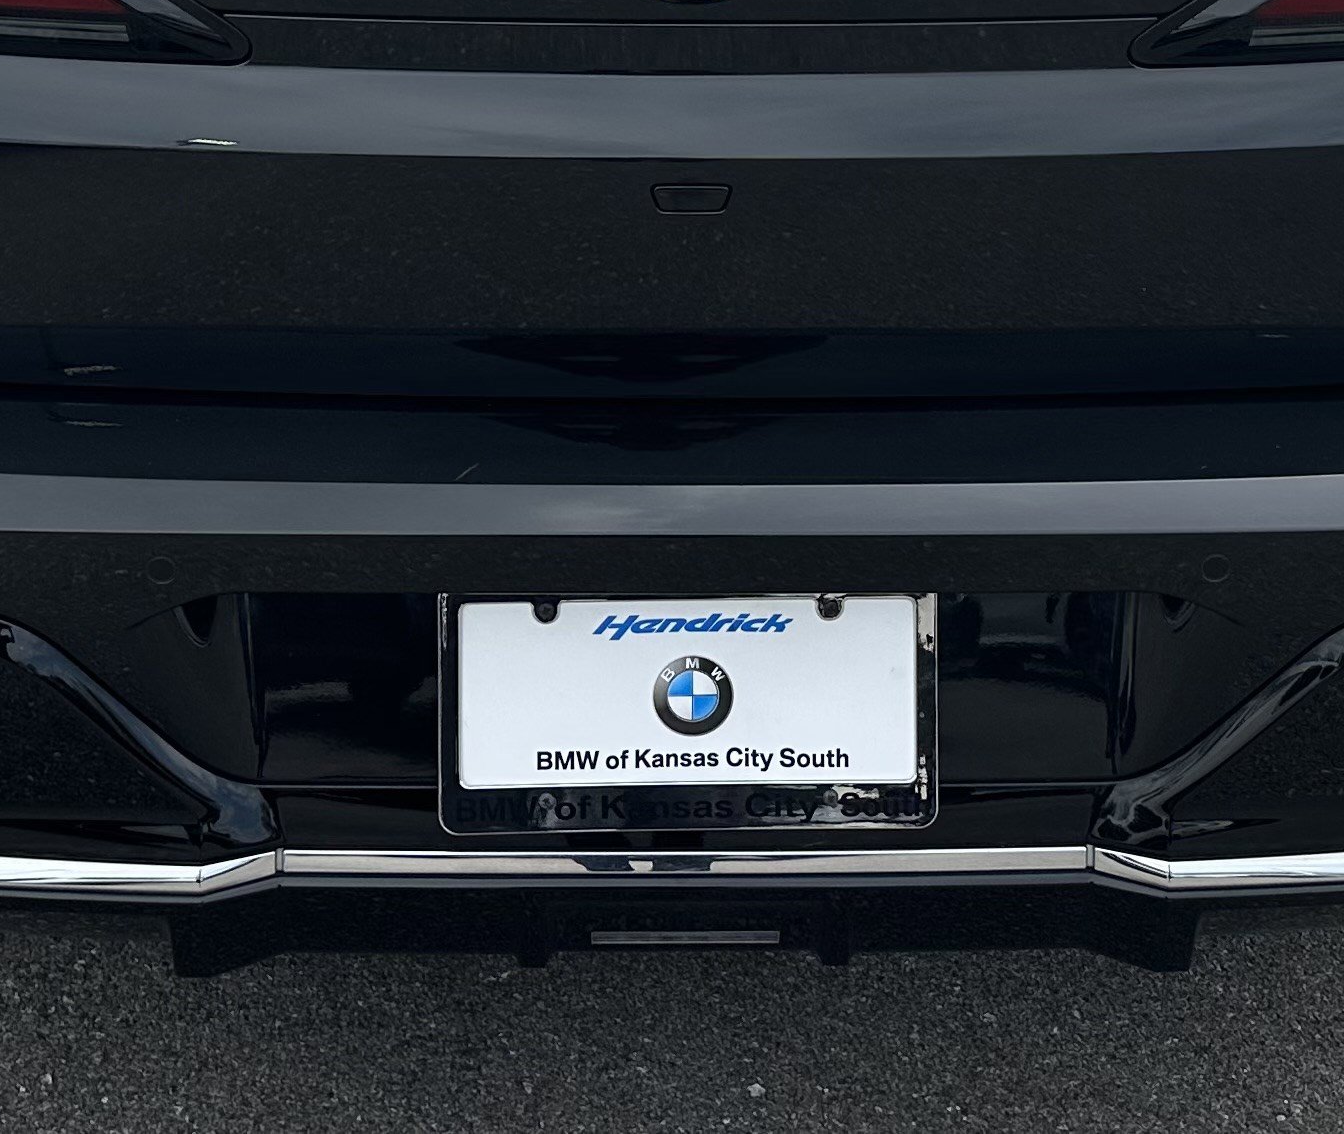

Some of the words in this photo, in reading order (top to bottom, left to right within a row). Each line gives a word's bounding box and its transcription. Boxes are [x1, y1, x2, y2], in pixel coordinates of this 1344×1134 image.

[592, 613, 794, 641] Hendrick
[661, 657, 726, 683] BMW
[537, 750, 600, 770] BMW
[606, 749, 629, 770] of
[635, 748, 719, 768] Kansas
[726, 747, 774, 772] City
[779, 747, 850, 768] South
[555, 794, 592, 821] of
